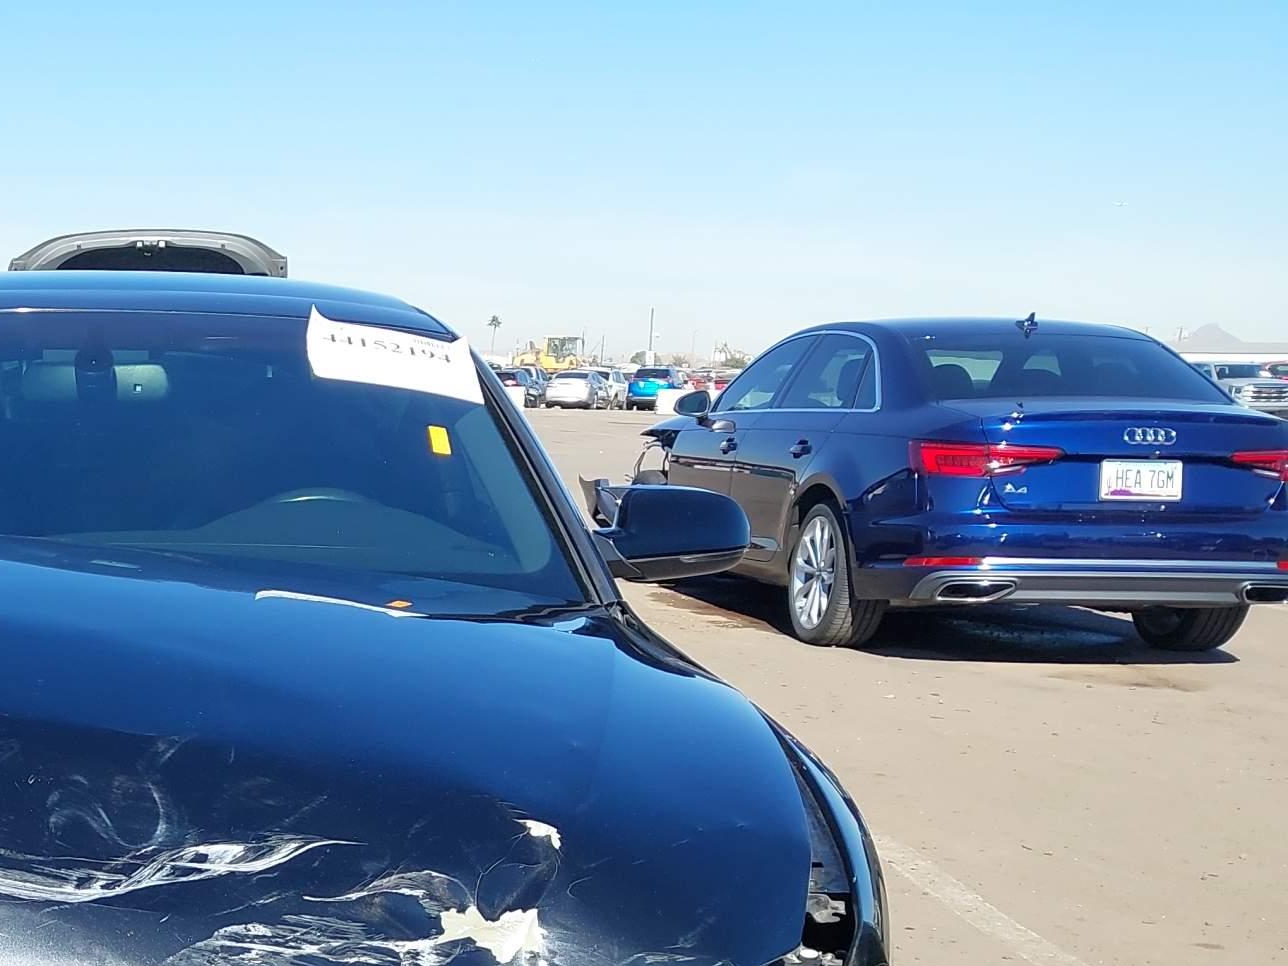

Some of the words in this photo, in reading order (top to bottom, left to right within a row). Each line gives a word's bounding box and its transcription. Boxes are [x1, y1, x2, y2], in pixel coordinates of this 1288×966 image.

[1115, 468, 1142, 489] HEA
[1148, 469, 1174, 489] 7GM
[1003, 482, 1028, 494] A4
